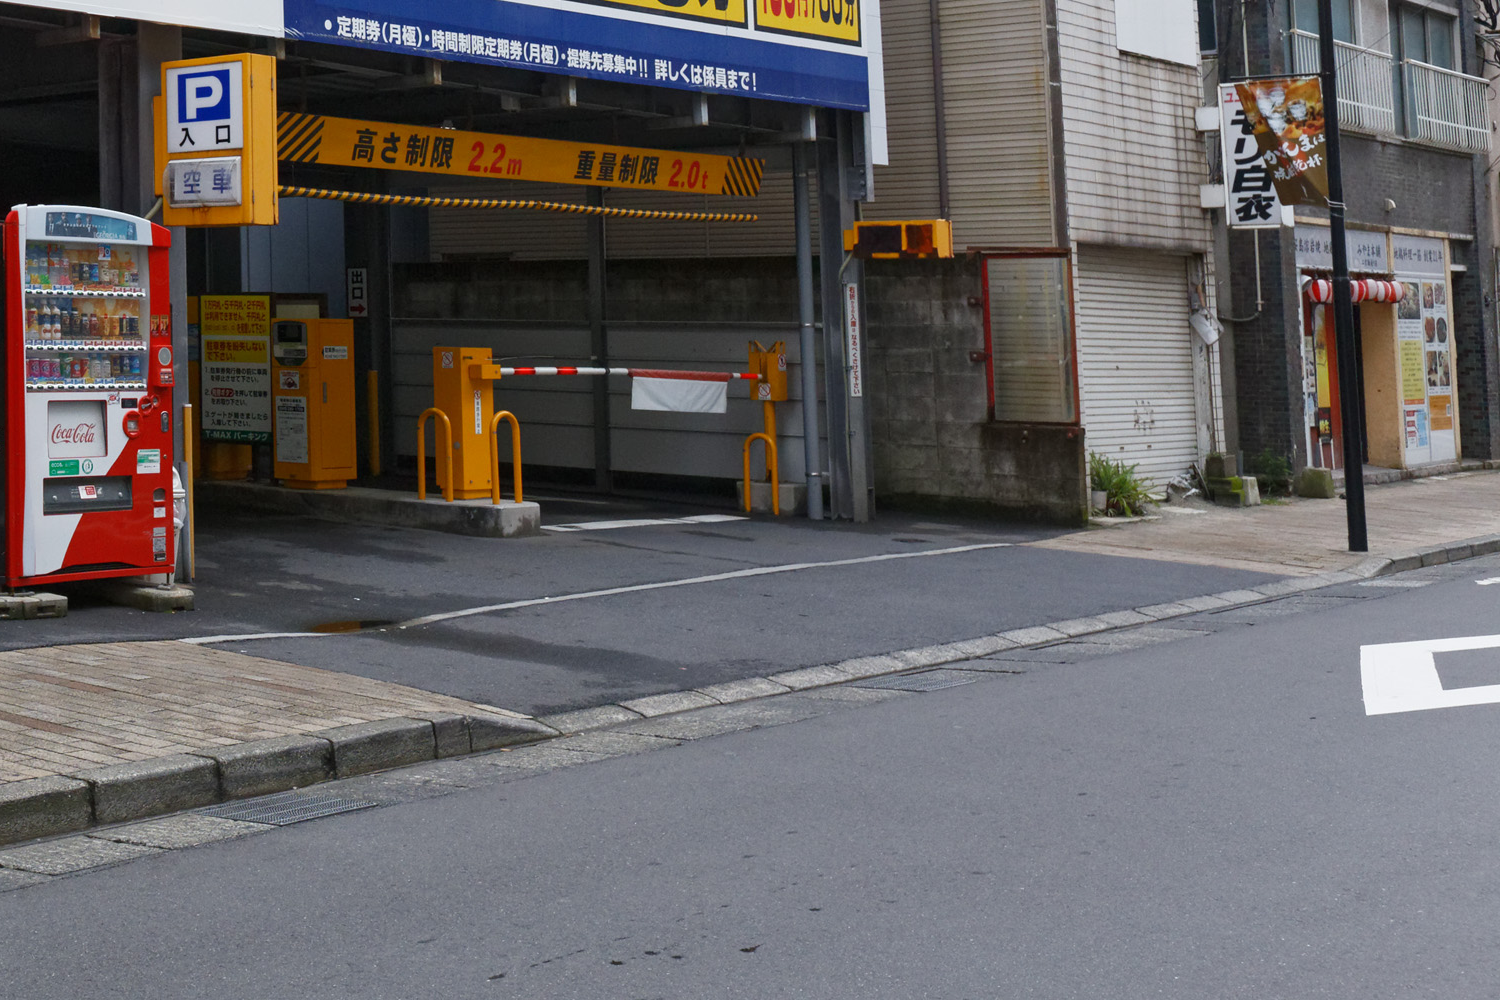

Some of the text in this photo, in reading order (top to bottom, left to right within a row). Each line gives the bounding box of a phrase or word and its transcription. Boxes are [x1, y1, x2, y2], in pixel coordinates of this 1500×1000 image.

[185, 75, 223, 120] P
[179, 124, 231, 147] 入口
[351, 128, 710, 190] 高さ制限 2.2m 重量制限 2.0t
[183, 167, 232, 194] 空車
[351, 270, 363, 300] 出口
[51, 423, 96, 444] Coca-Cola
